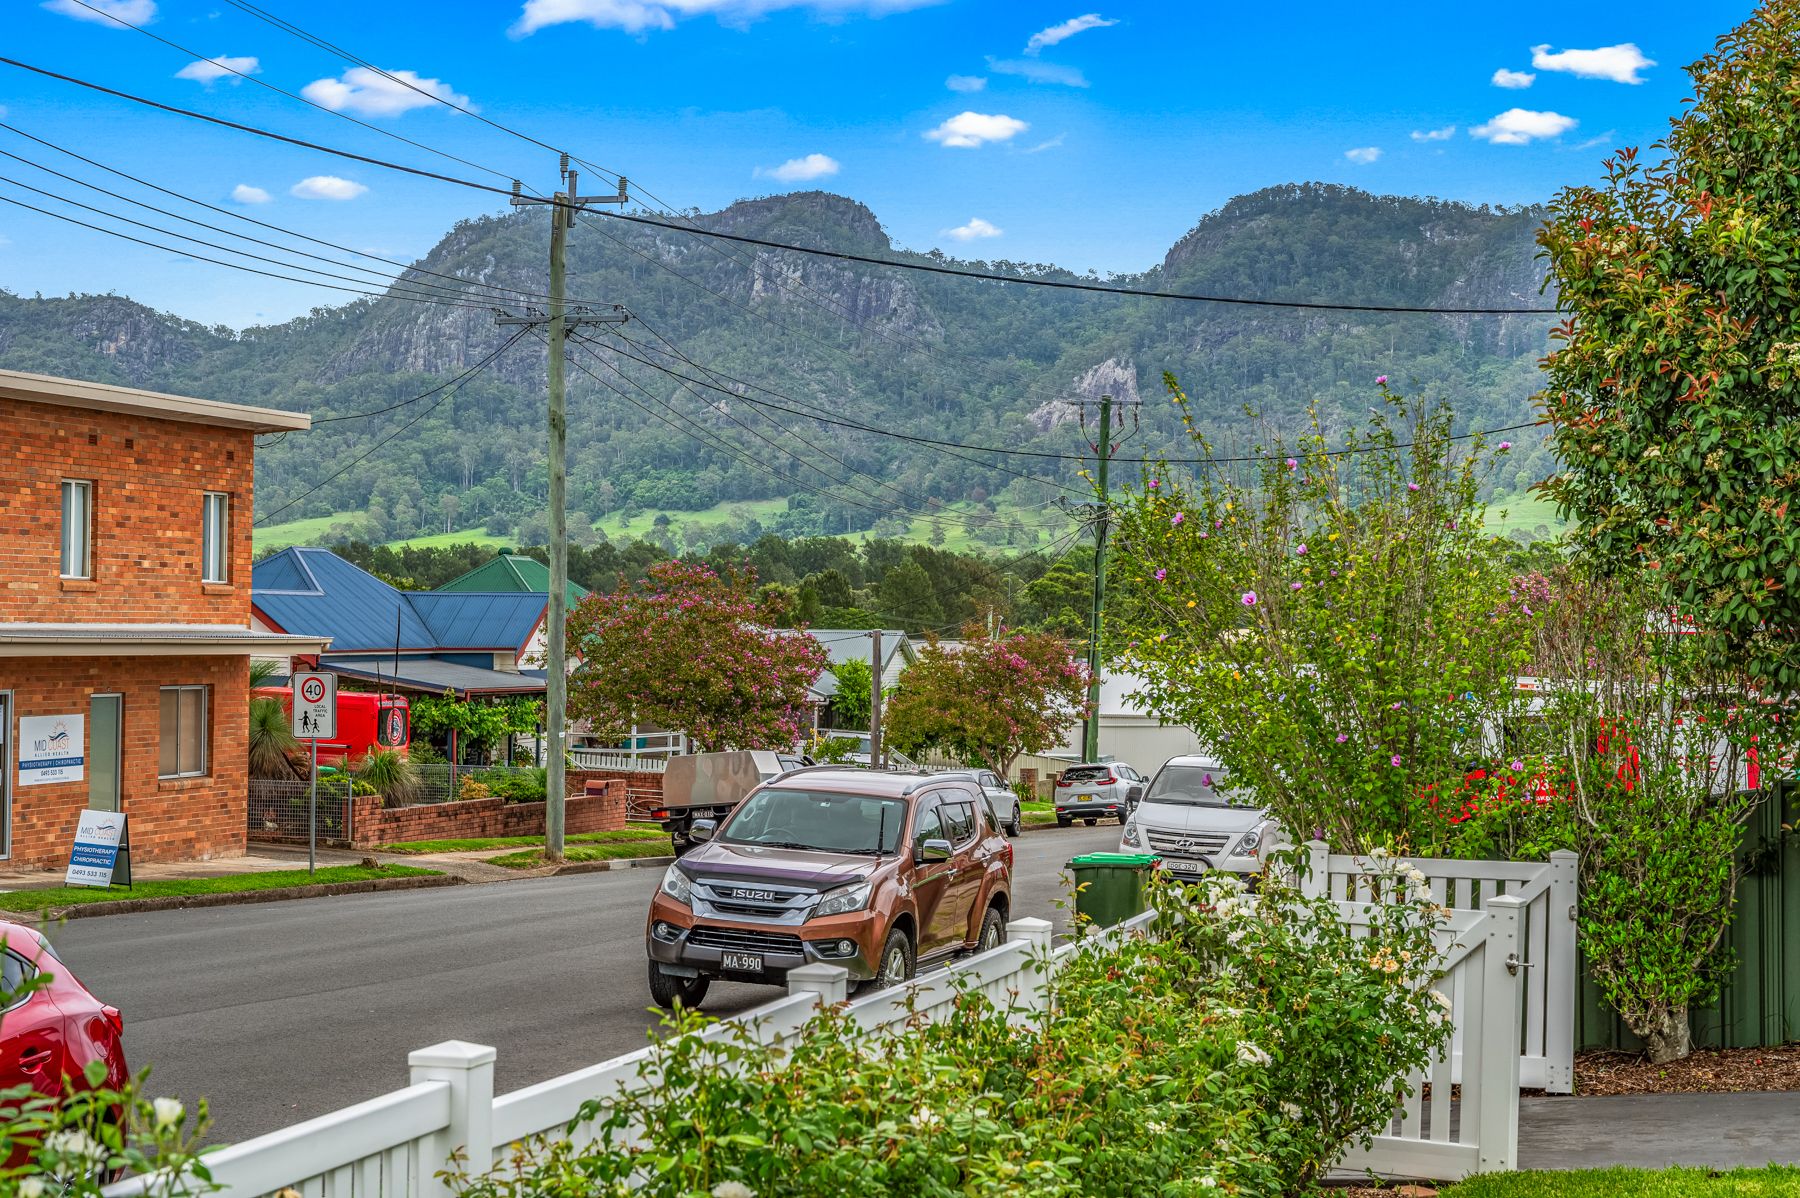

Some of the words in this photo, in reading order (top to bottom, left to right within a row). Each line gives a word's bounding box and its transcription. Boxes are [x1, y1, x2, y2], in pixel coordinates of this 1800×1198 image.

[305, 685, 322, 696] 40
[34, 740, 47, 752] MID
[48, 738, 70, 751] COAST
[21, 760, 52, 768] PHYSIOTHERAPY
[55, 758, 82, 766] CHIROPRACTIC
[80, 826, 94, 835] MID
[95, 828, 116, 838] COAST
[73, 845, 116, 855] PHYSIOTHERAPY
[73, 856, 112, 865] CHIROPRACTIC
[72, 868, 86, 876] 0493
[733, 889, 774, 900] ISUZU
